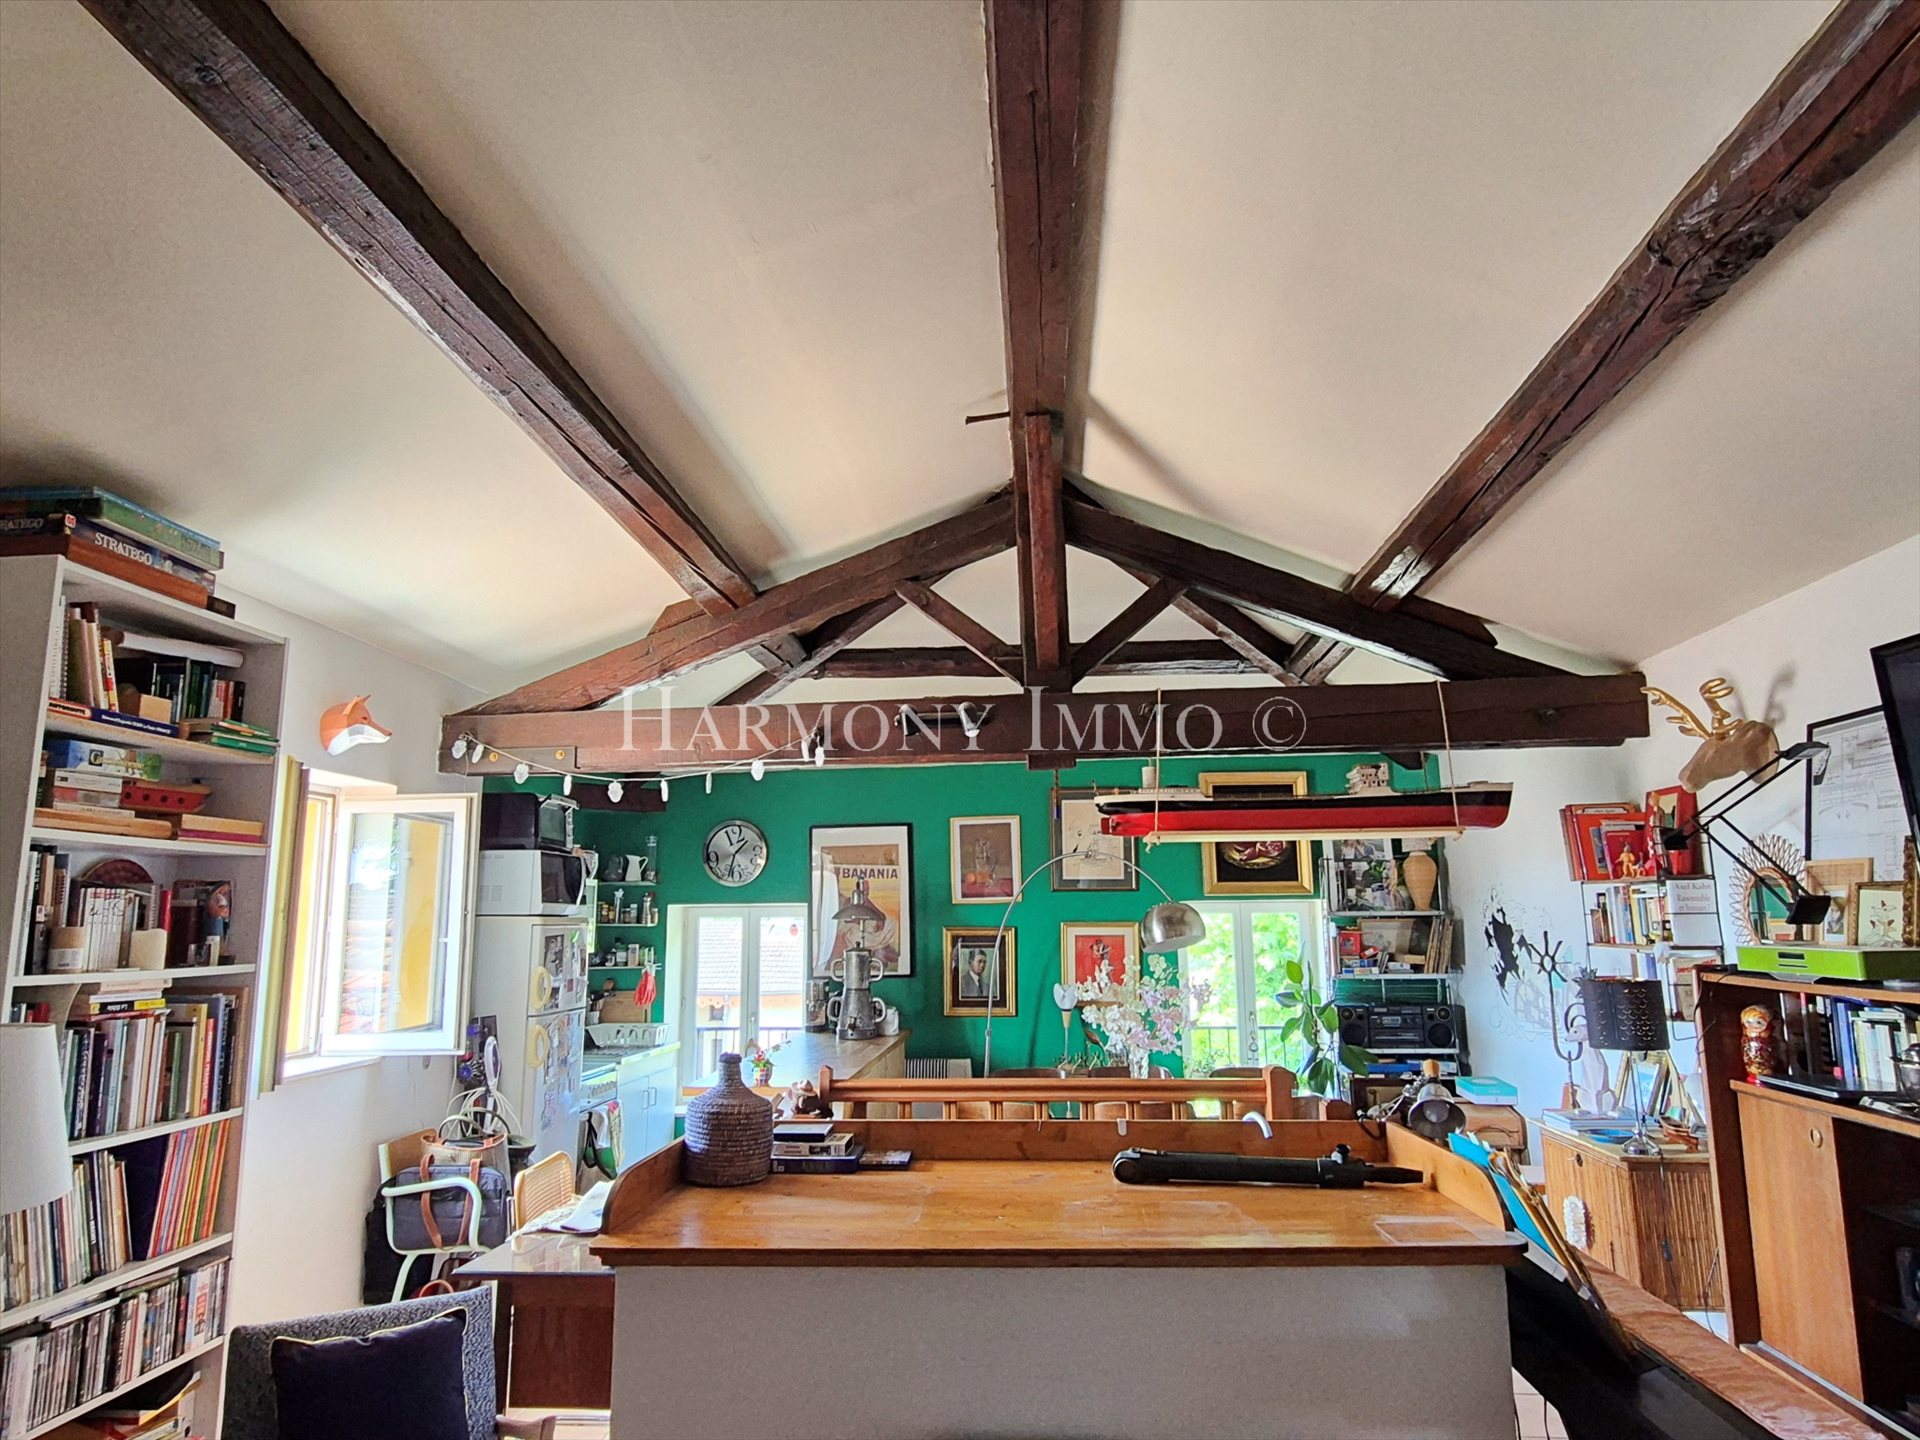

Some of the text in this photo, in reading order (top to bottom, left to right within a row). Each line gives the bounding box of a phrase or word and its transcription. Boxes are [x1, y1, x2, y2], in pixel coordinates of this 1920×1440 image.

[95, 532, 153, 566] STRATEGO
[724, 825, 745, 846] 12
[707, 850, 719, 868] 9
[731, 863, 742, 883] 6
[842, 867, 898, 880] BANANIA
